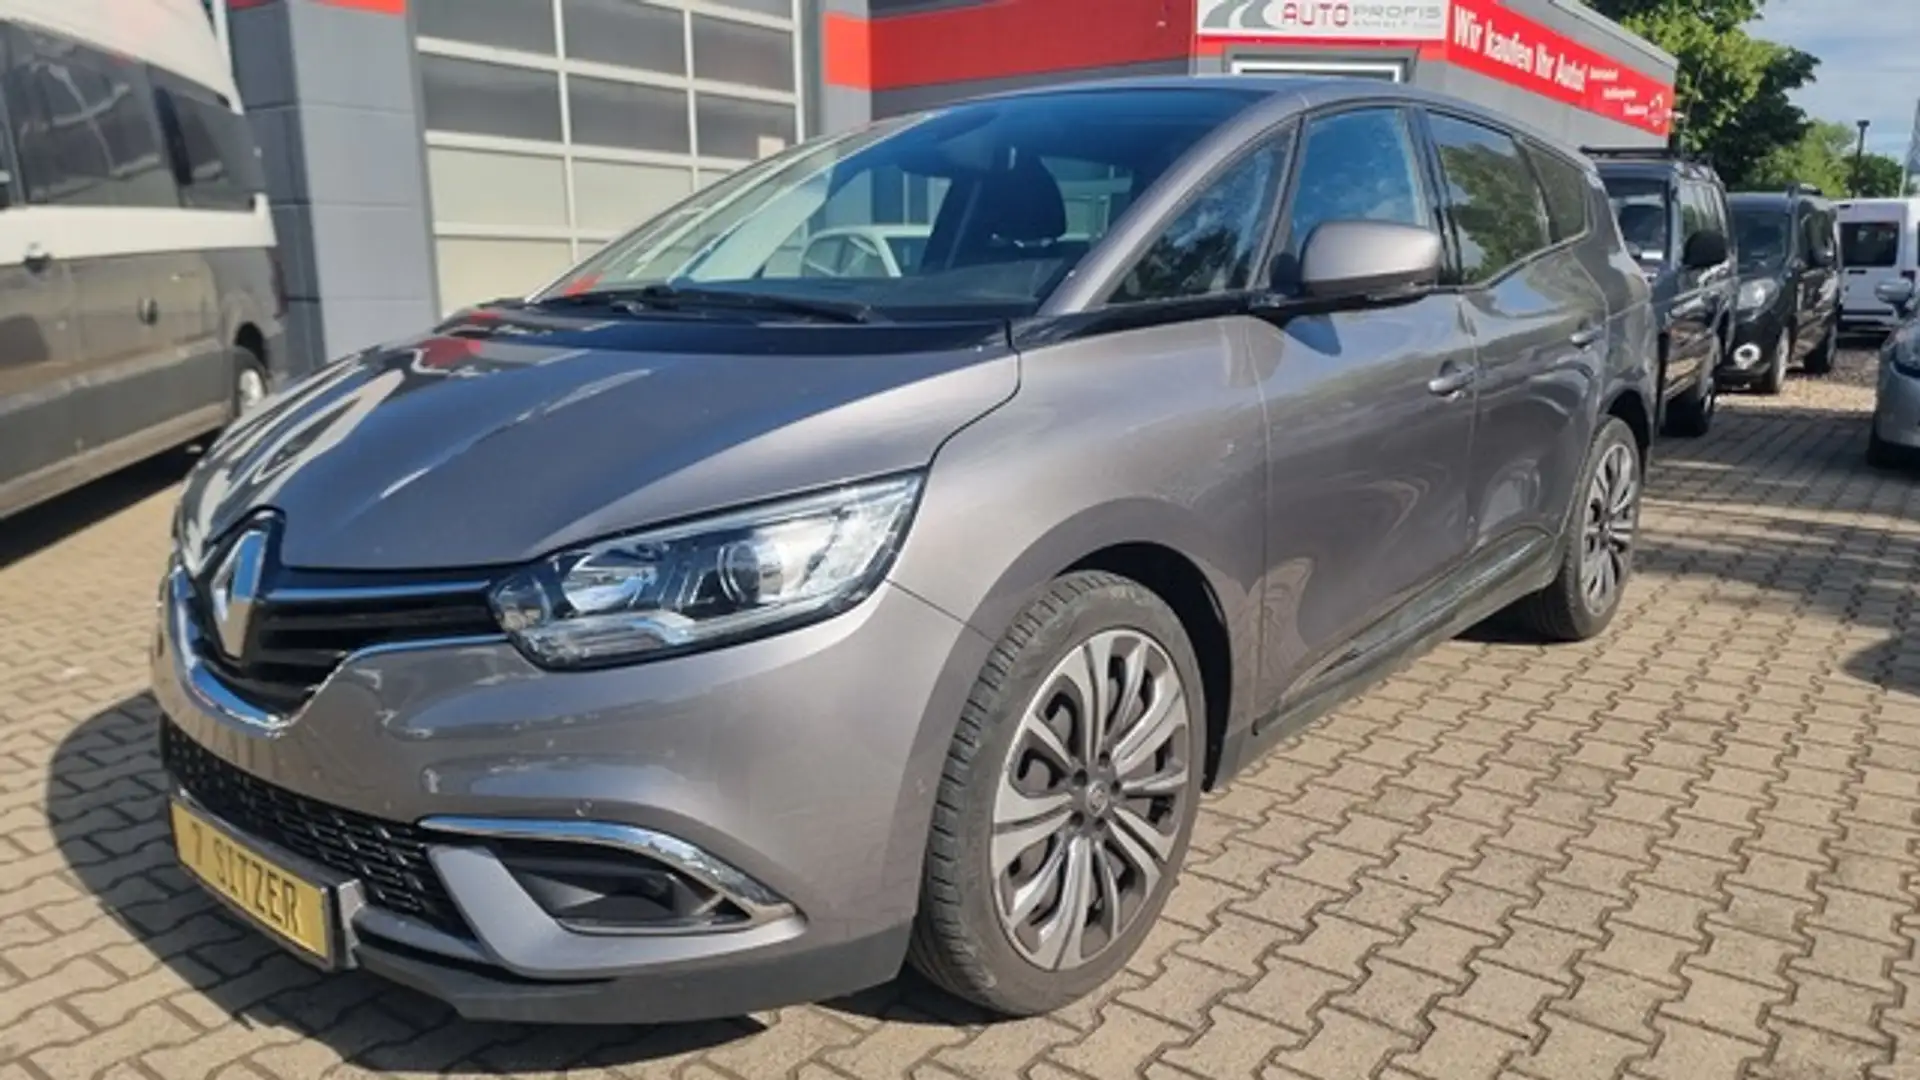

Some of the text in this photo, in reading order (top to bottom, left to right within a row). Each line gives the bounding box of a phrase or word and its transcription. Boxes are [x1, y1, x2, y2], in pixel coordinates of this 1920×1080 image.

[1283, 2, 1350, 26] AUTO
[1454, 5, 1483, 52] Wir
[1484, 19, 1533, 73] kaufen
[1535, 42, 1556, 80] Ihr
[191, 821, 301, 935] 7 SITZER
